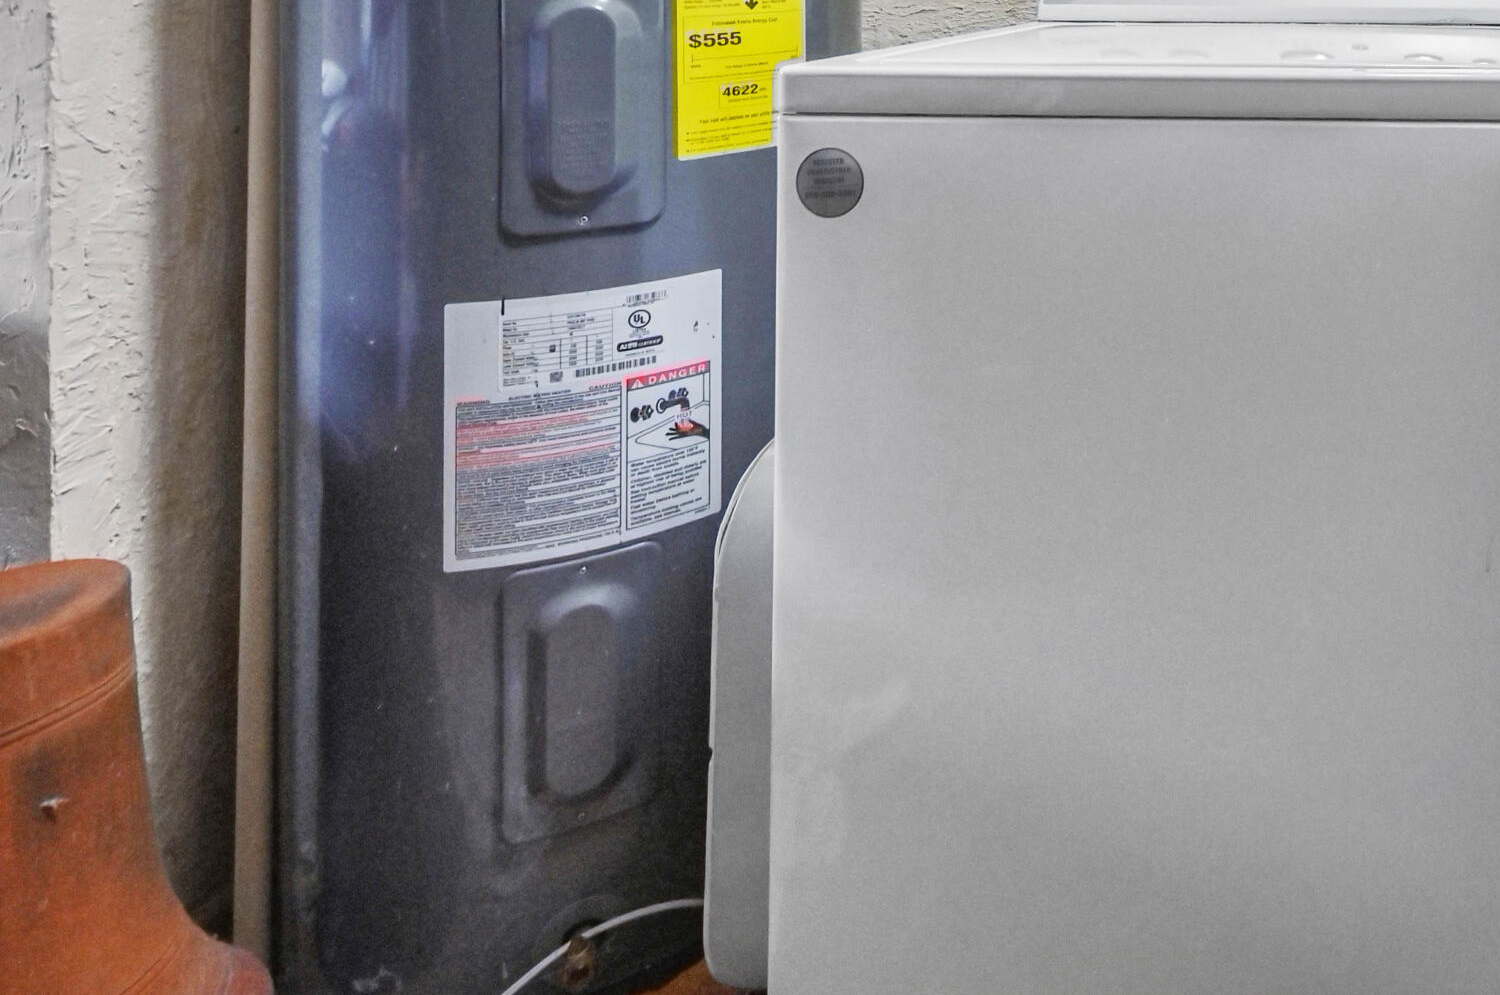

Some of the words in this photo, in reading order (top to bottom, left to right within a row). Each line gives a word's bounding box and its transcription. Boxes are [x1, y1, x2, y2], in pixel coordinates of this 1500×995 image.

[688, 31, 742, 49] $555
[722, 83, 758, 97] 4622
[648, 363, 706, 385] DANGER
